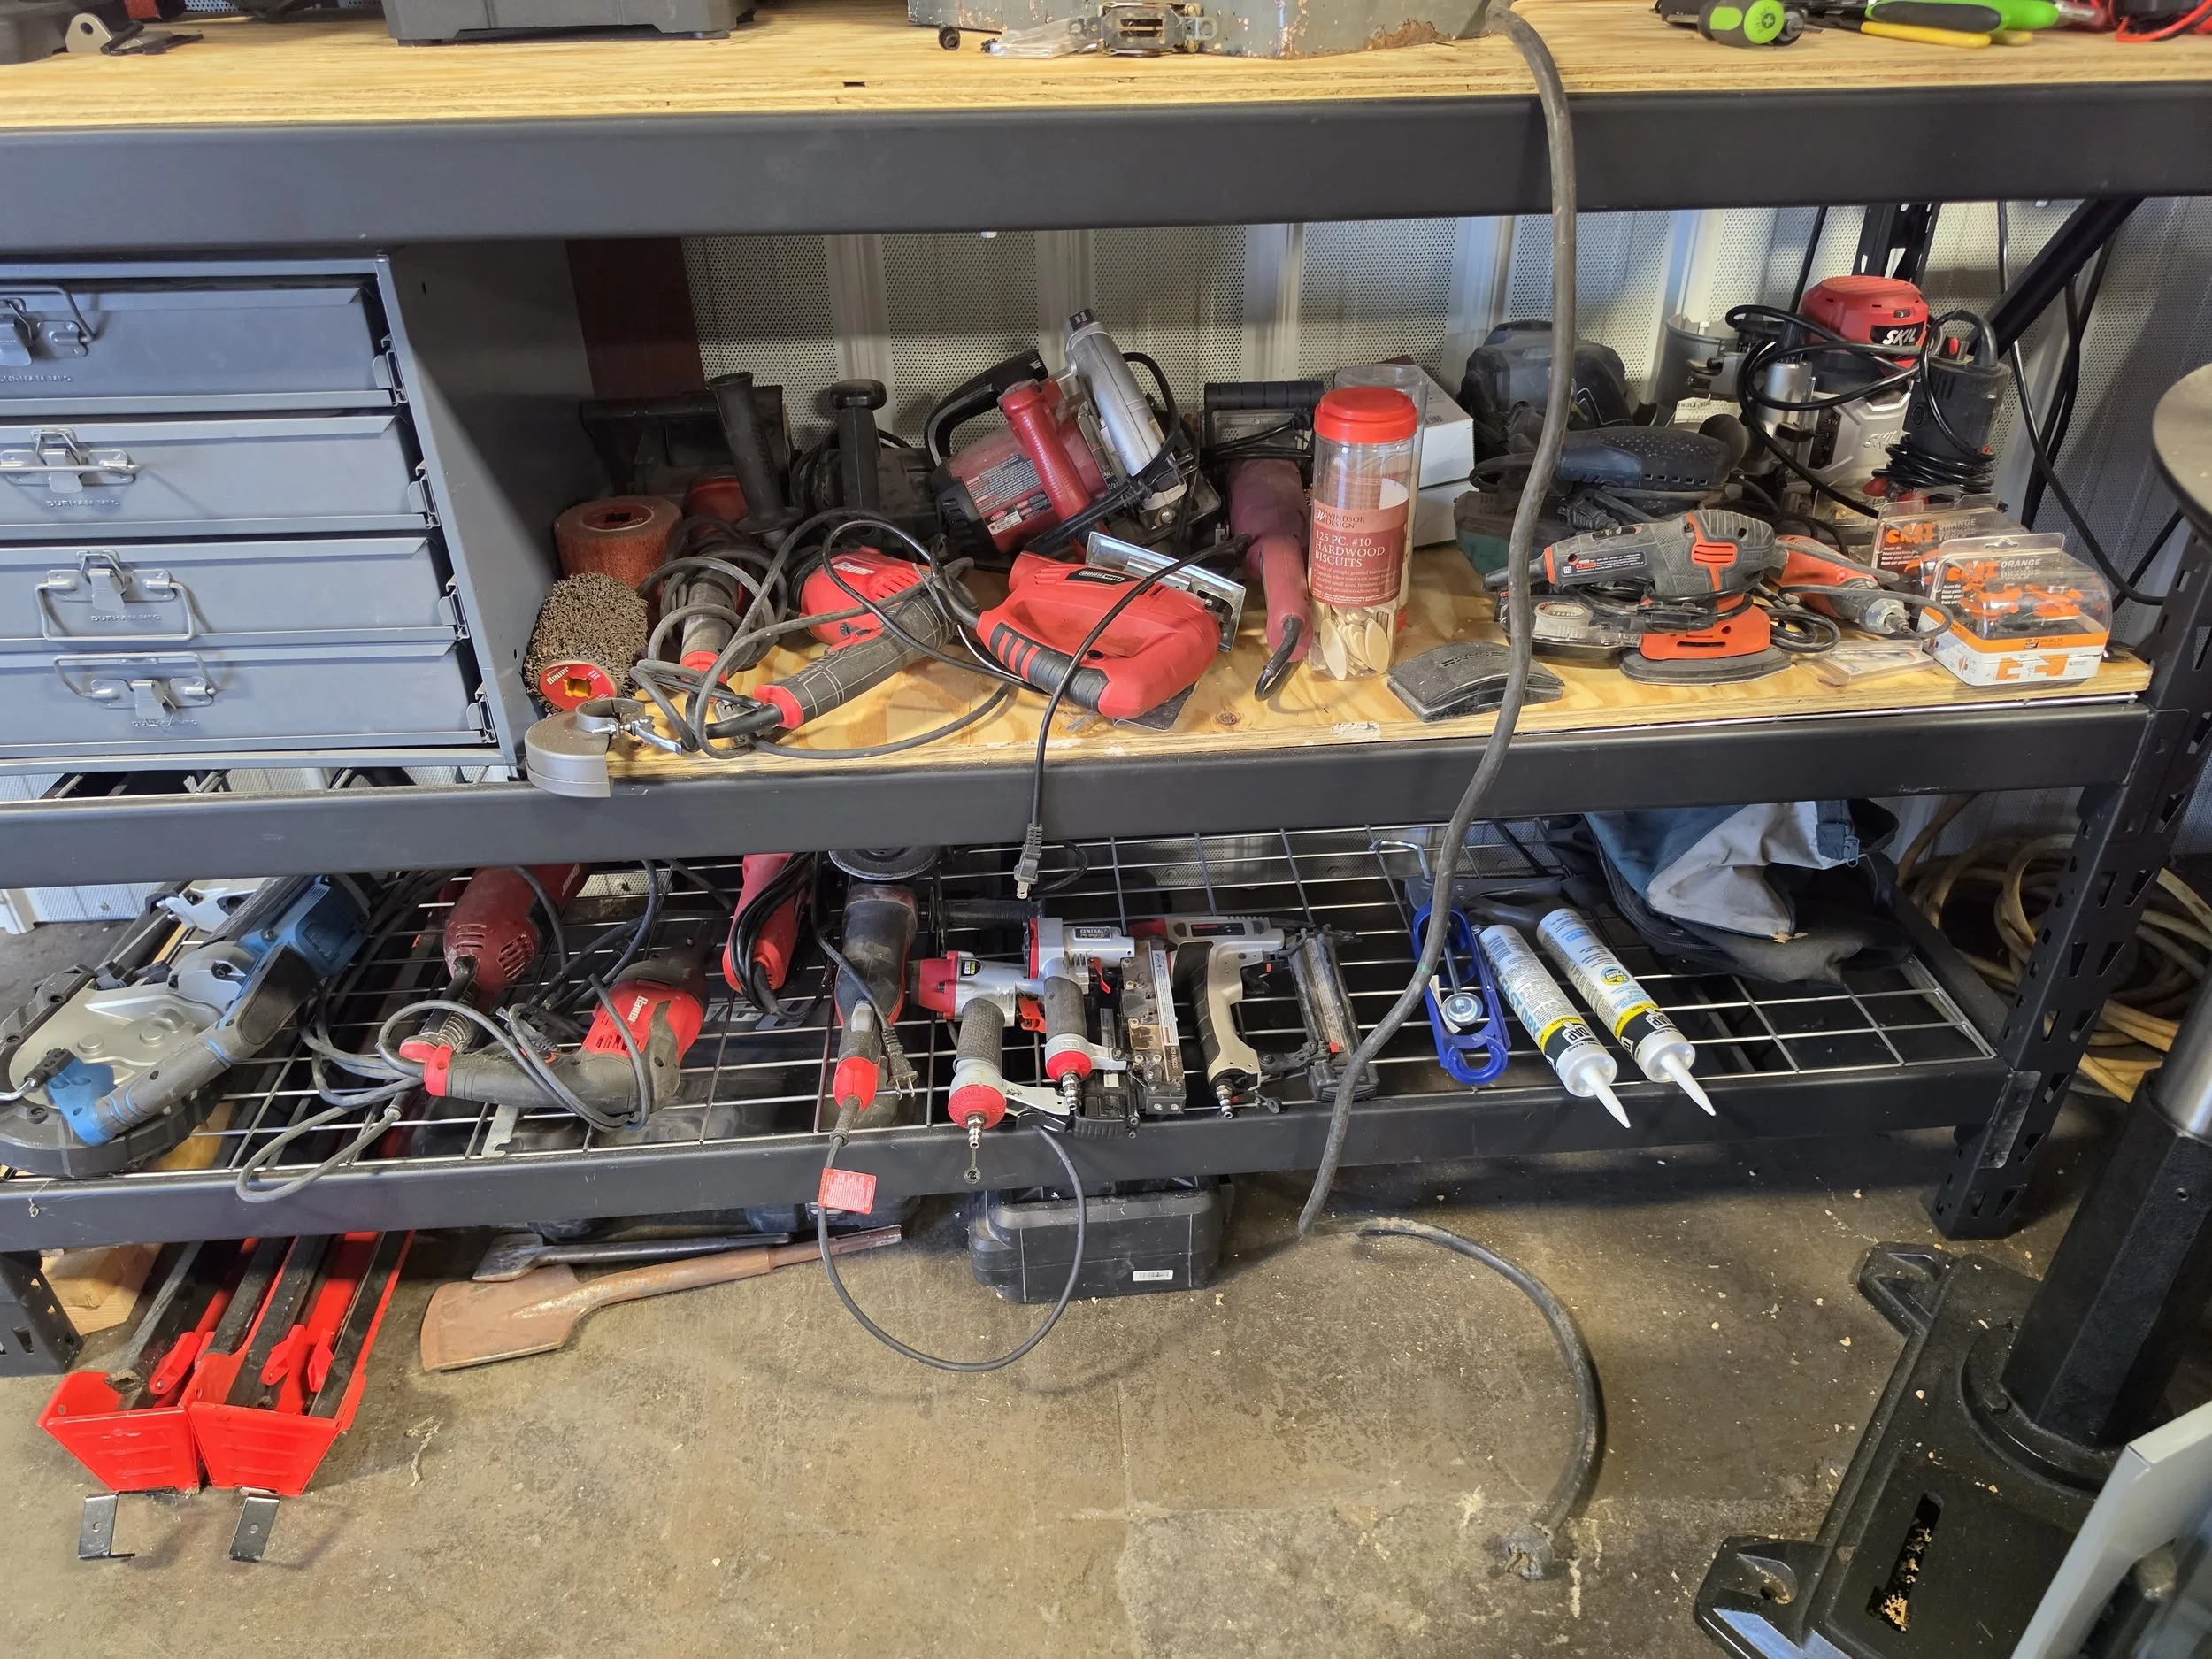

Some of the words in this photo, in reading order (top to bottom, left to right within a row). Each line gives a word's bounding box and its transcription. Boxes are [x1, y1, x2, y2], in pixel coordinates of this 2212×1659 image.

[1882, 328, 1916, 347] SKIL
[1325, 518, 1356, 529] DESIGN
[1326, 511, 1365, 523] WINDSOR
[1317, 530, 1329, 541] 125
[1332, 535, 1349, 546] PC.
[1352, 538, 1371, 547] #10
[1316, 540, 1386, 557] HARDWOOD
[1315, 550, 1363, 568] BISCUITS
[2001, 558, 2042, 568] ORANGE
[832, 561, 877, 575] Bauer
[546, 666, 570, 685] Bauer
[627, 995, 649, 1024] Bauer
[1500, 979, 1522, 1010] FAST
[1521, 1009, 1541, 1037] DRY
[1568, 1026, 1592, 1041] DAP
